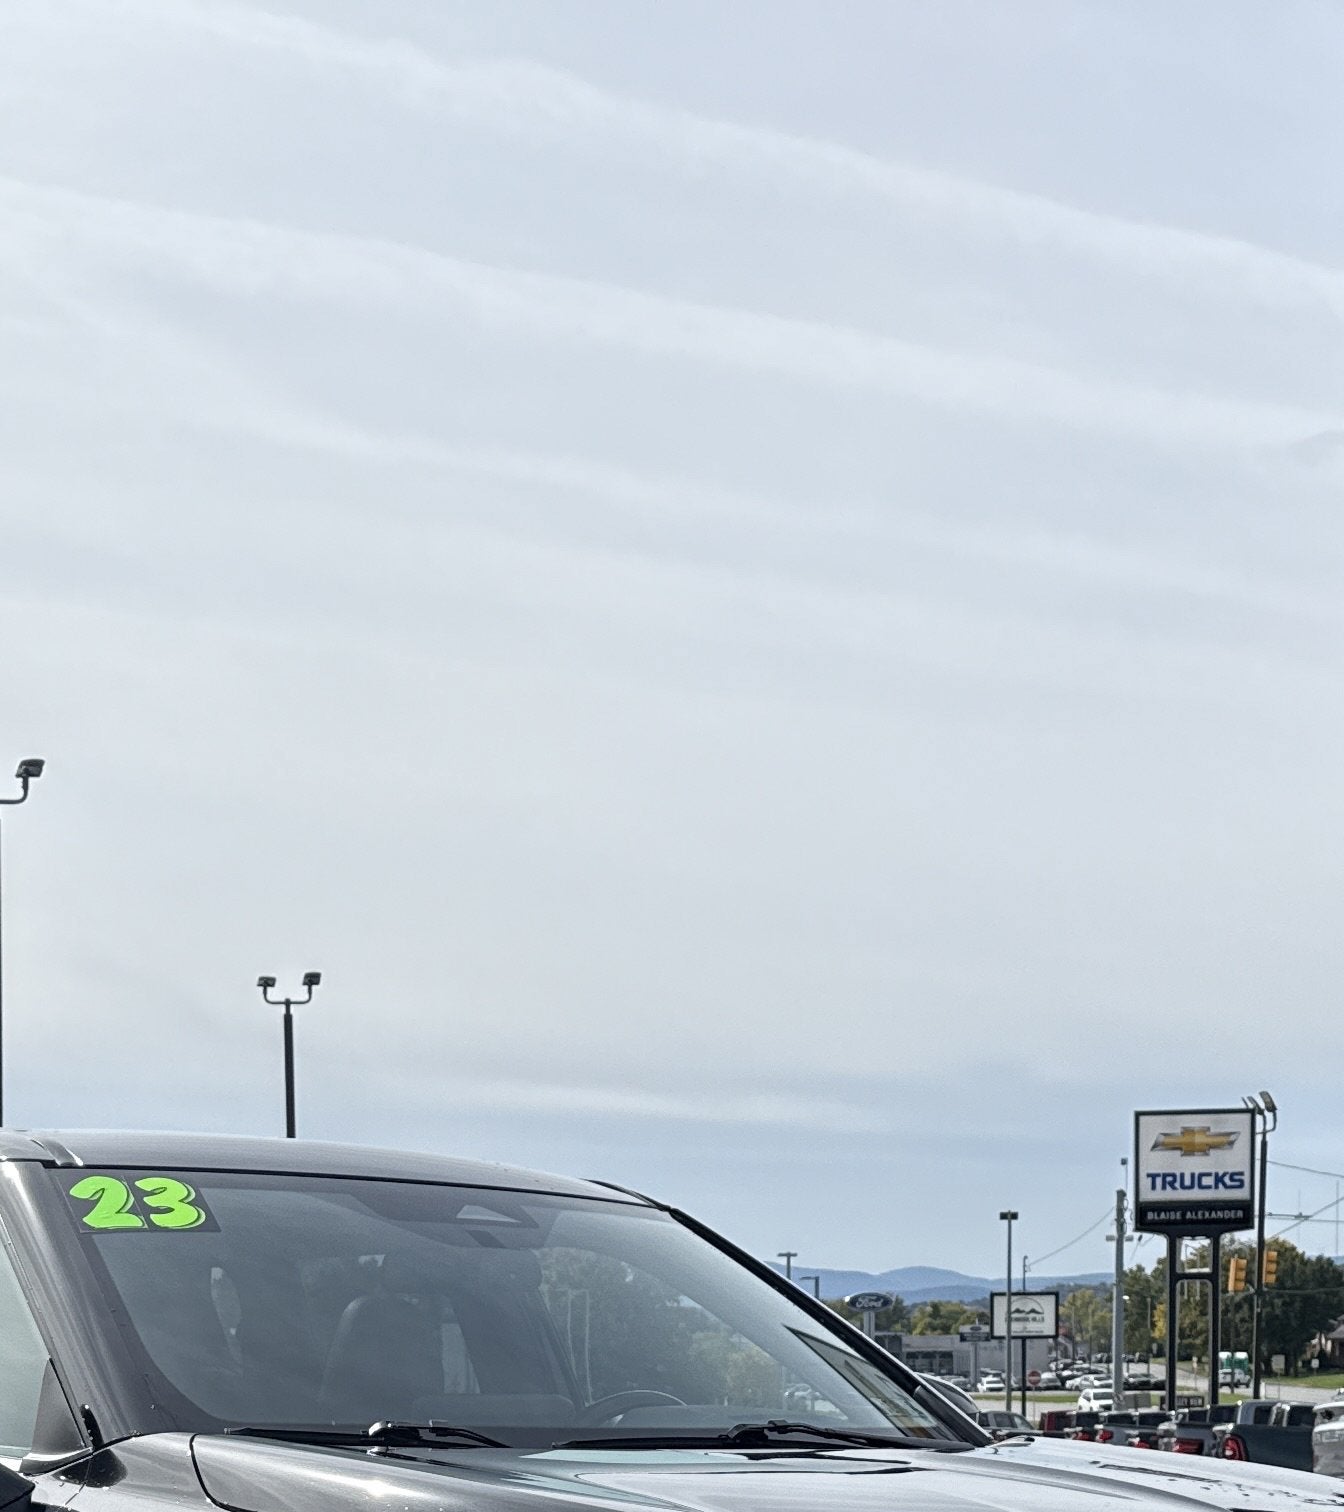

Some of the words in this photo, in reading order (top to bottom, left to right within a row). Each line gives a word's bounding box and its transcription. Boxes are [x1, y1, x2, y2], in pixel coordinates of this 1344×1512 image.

[1146, 1171, 1246, 1192] TRUCKS
[69, 1175, 206, 1230] 23
[1147, 1210, 1183, 1220] BLAISE
[1185, 1209, 1244, 1220] ALEXANDER
